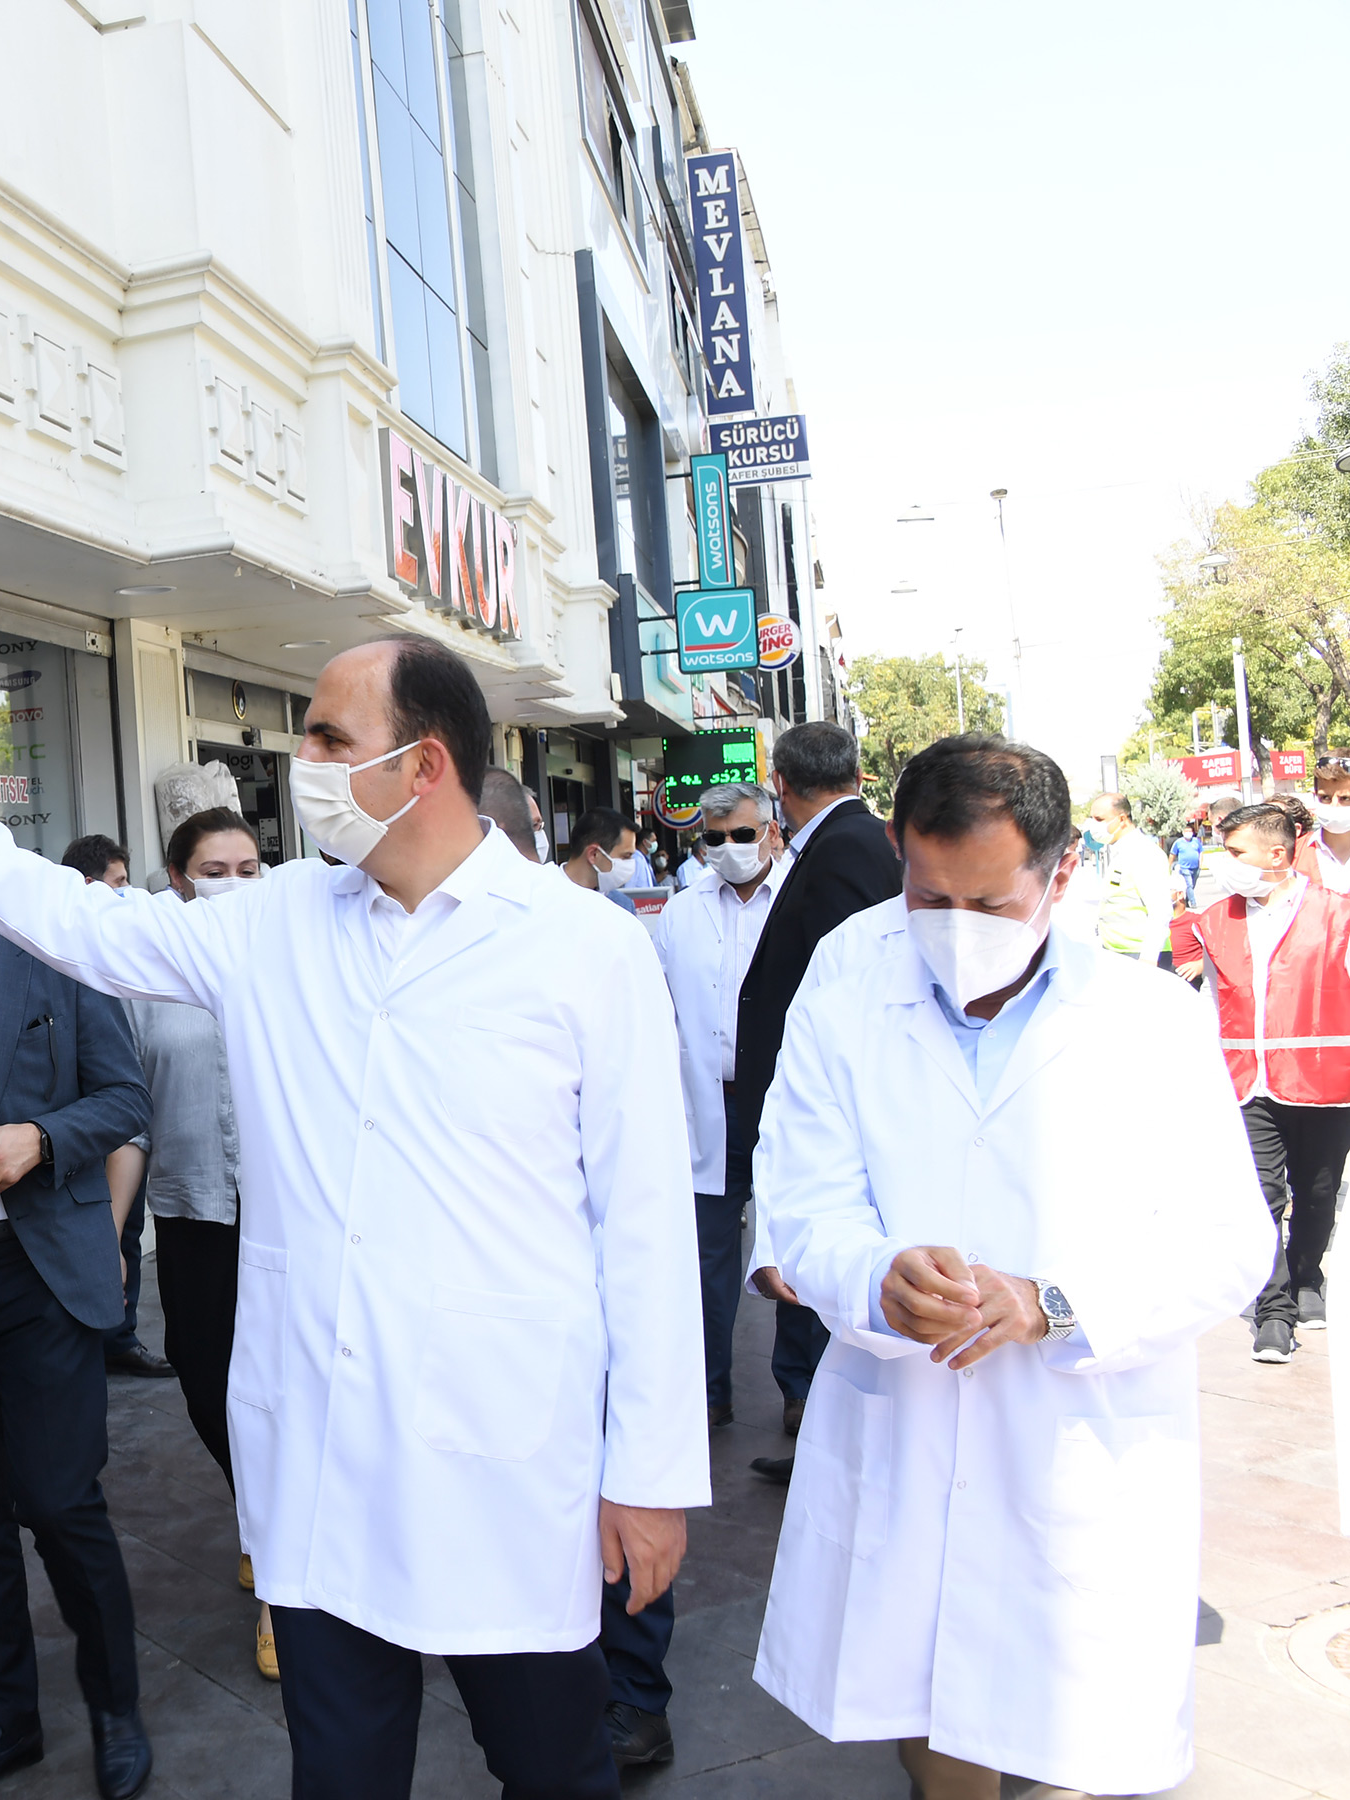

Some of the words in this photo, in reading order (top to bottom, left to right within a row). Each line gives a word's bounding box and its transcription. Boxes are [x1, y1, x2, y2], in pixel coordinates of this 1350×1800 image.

[694, 164, 745, 399] MEVLANA
[719, 417, 799, 447] SÜRÜCÜ
[728, 443, 795, 467] KURSU
[761, 462, 800, 478] ŞUBESİ
[704, 481, 723, 570] watsons
[382, 427, 522, 641] EVKUR
[759, 623, 791, 639] URGER
[684, 651, 755, 666] watsons
[226, 753, 254, 770] logi
[1202, 756, 1232, 769] ZAFER
[1279, 755, 1302, 765] ZAFER
[1208, 766, 1233, 777] BÜFE
[1284, 764, 1303, 774] BÜFE
